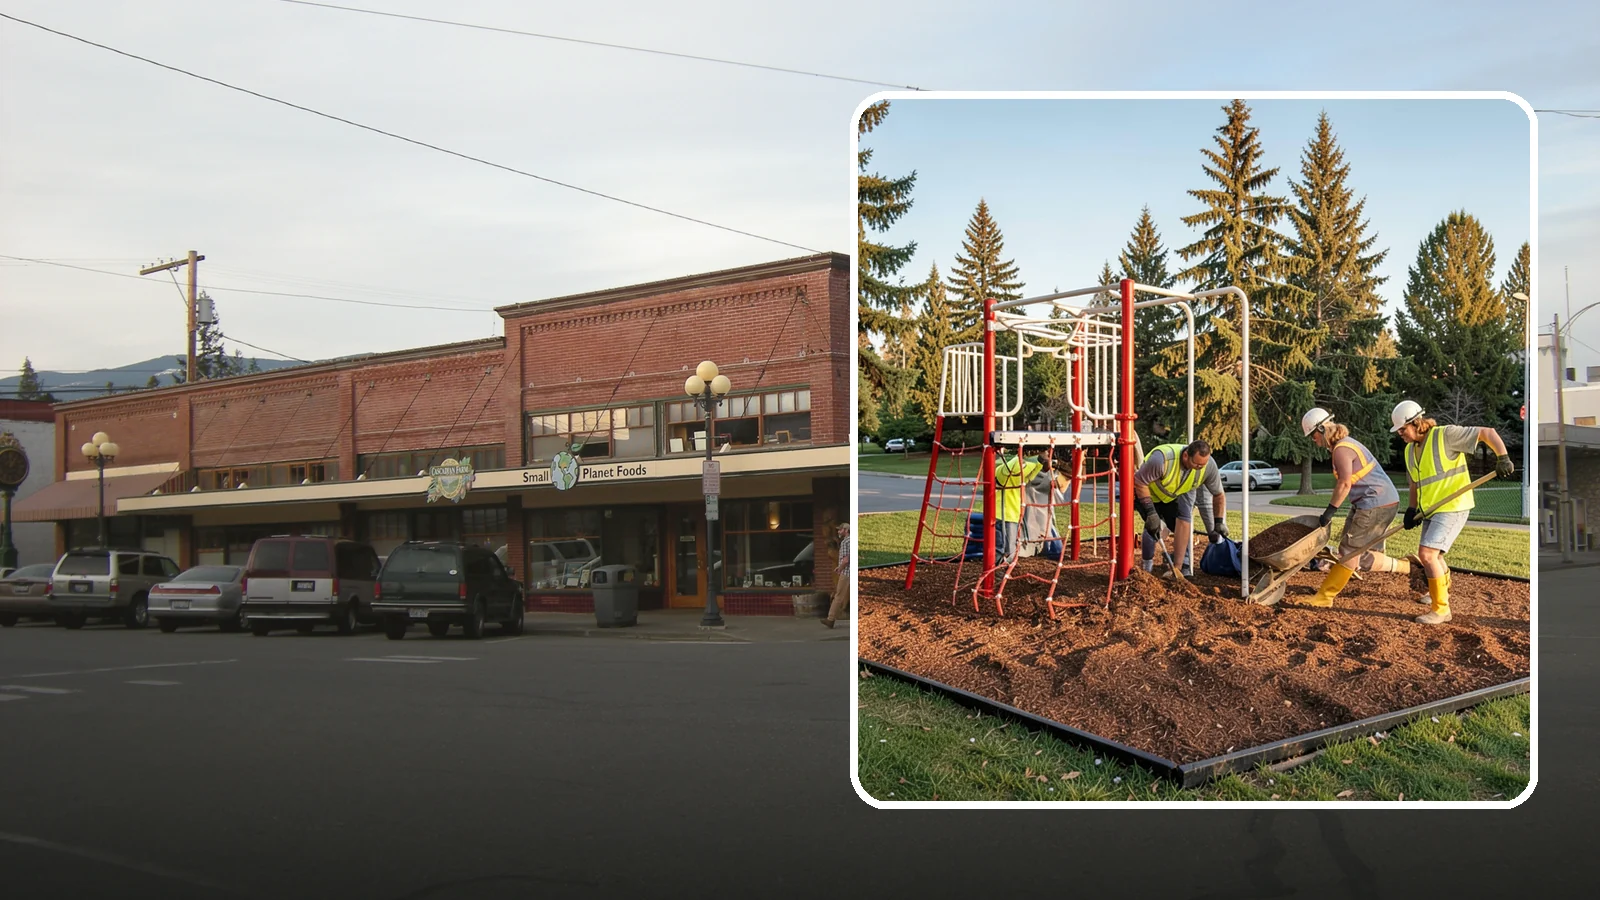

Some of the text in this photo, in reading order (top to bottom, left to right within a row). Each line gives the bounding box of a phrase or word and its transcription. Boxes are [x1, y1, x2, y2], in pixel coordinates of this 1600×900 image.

[523, 464, 647, 483] Small Planet Foods
